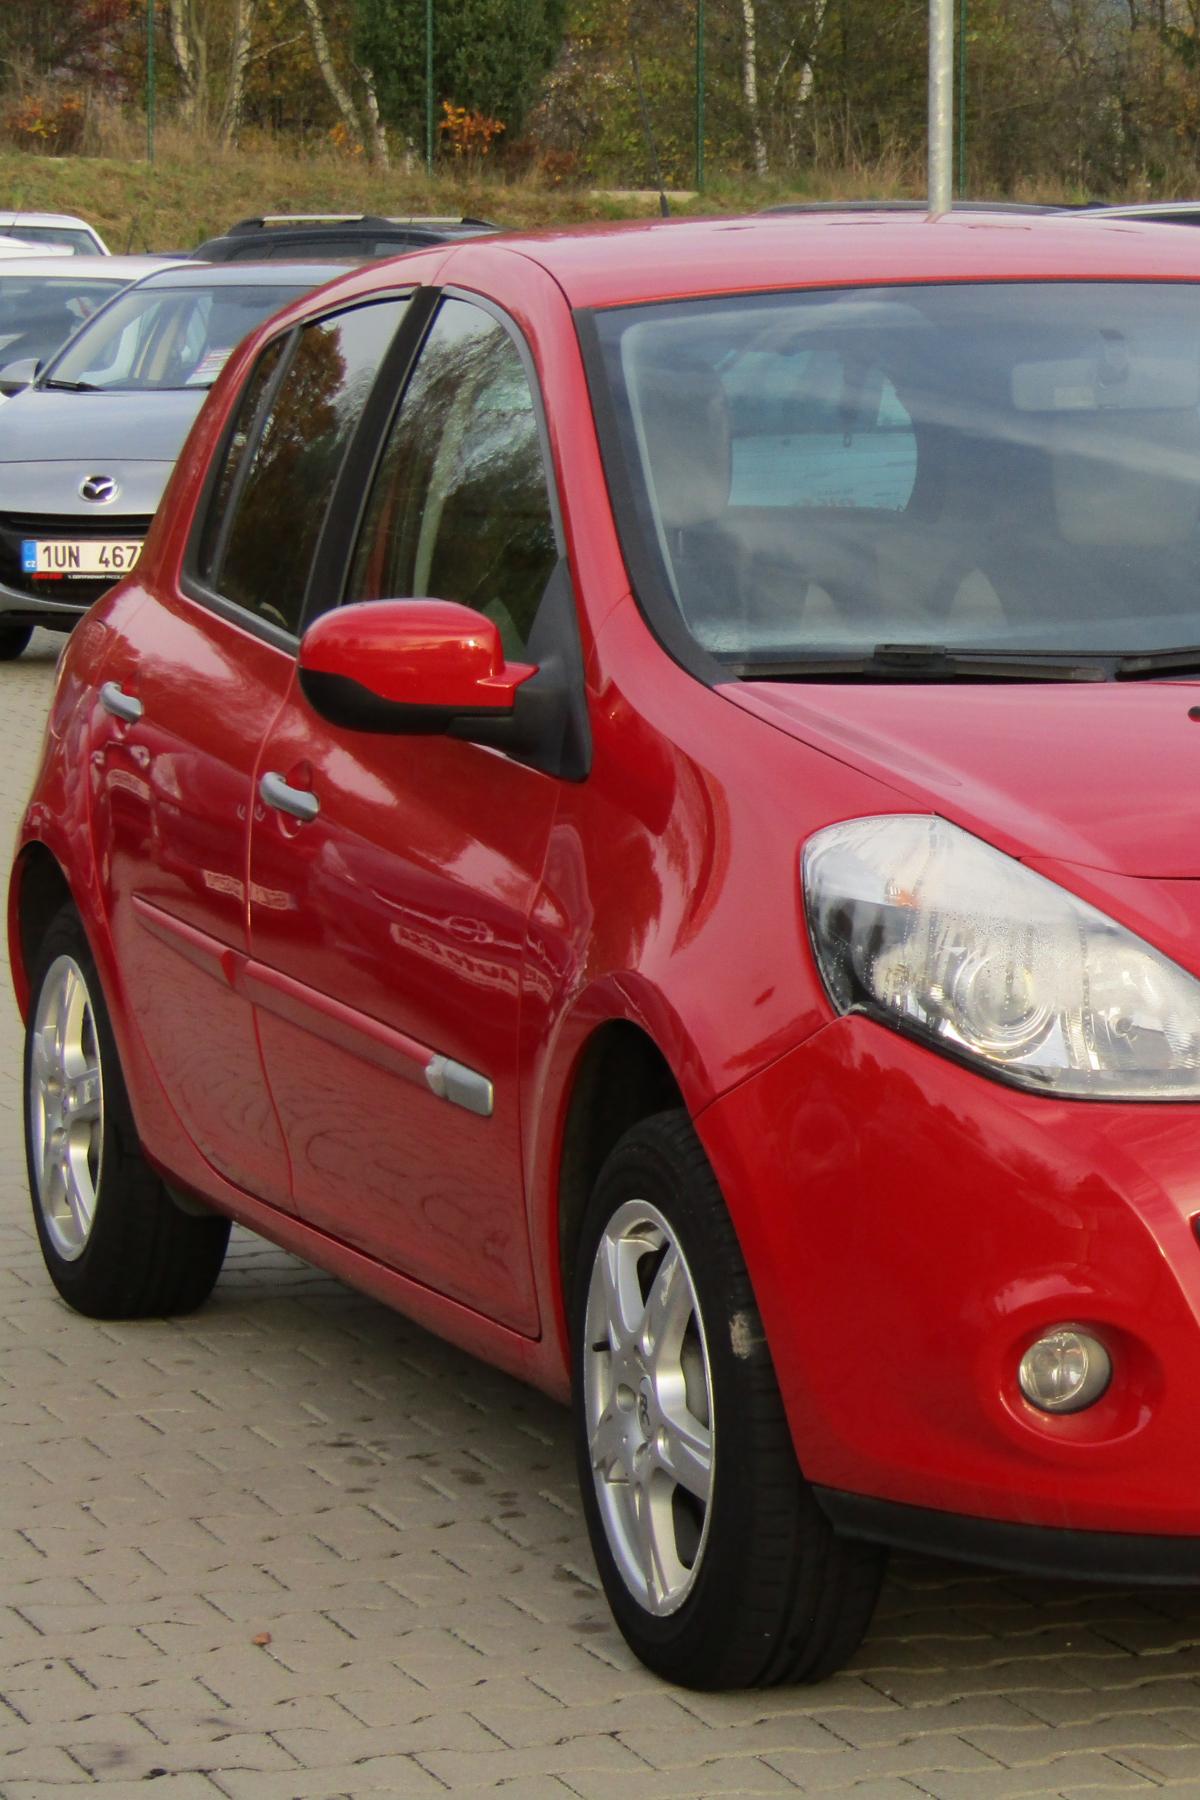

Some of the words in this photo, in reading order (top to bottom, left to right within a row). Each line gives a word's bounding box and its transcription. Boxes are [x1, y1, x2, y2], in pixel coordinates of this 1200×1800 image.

[25, 560, 37, 568] CZ
[43, 545, 80, 568] 1UN
[99, 545, 144, 568] 467
